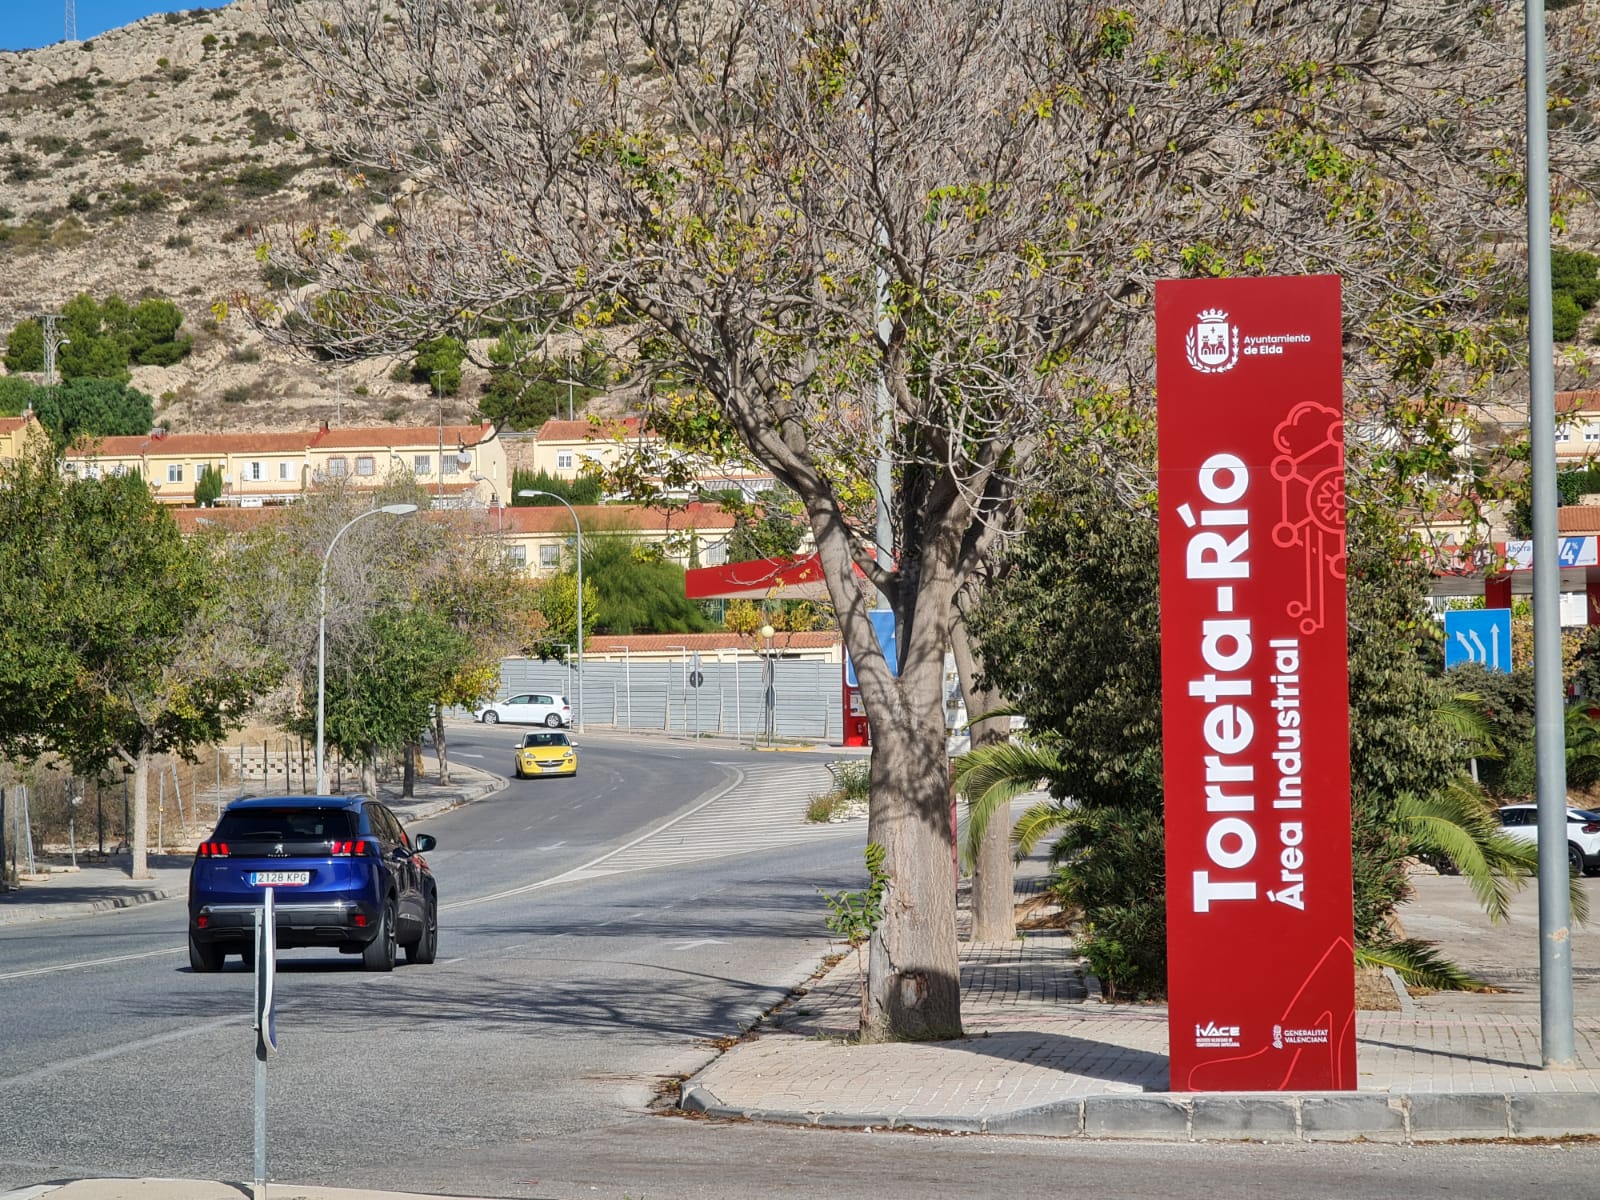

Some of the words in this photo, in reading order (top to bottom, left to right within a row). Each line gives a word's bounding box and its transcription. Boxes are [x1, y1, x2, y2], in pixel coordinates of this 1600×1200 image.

[1244, 334, 1310, 346] Ayuntamiento
[1243, 346, 1258, 355] de
[1260, 345, 1283, 355] Elda
[1176, 452, 1257, 913] Torreta-Río
[1269, 639, 1303, 809] Industrial
[1266, 821, 1305, 911] Área
[258, 873, 283, 883] 2128
[287, 873, 306, 883] KPG
[1284, 1029, 1328, 1037] GENERALITAT
